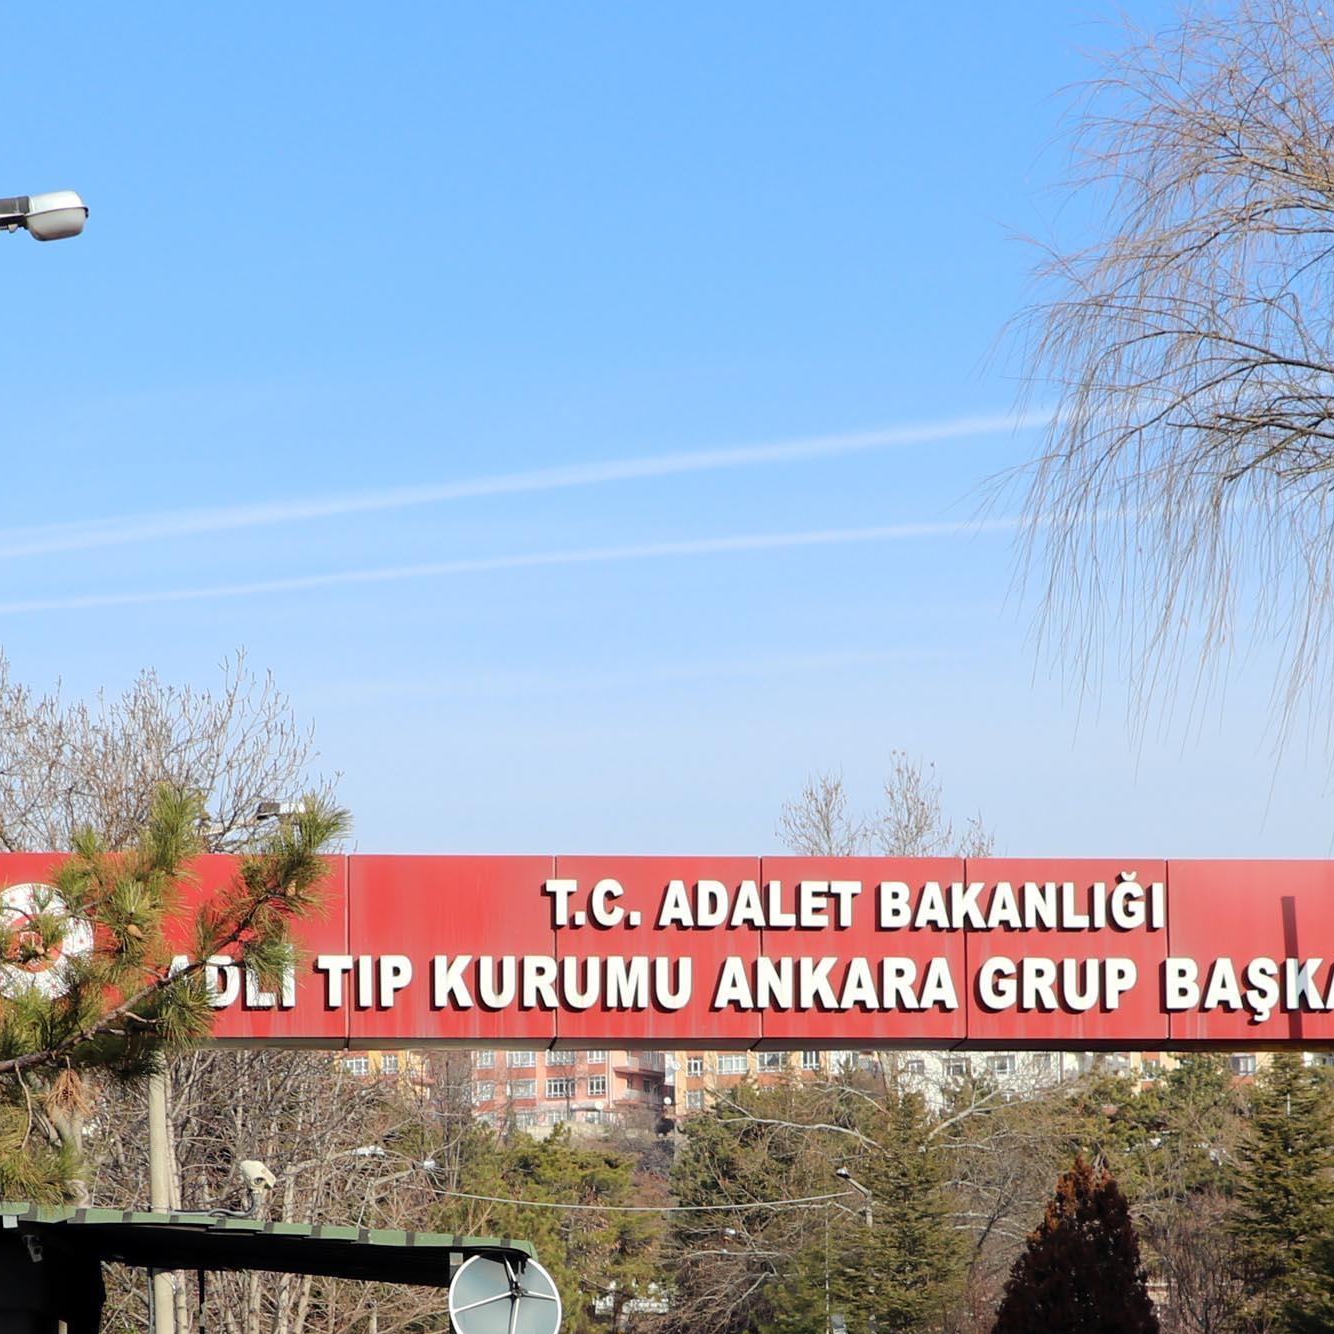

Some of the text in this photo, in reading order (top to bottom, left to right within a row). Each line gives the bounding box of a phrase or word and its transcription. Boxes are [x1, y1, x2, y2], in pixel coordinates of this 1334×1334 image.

[547, 872, 1165, 929] T.C. ADALET BAKANLIĞI
[318, 955, 413, 1007] TIP
[434, 955, 692, 1009] KURUMU
[714, 956, 959, 1009] ANKARA
[979, 956, 1137, 1010] GRUP
